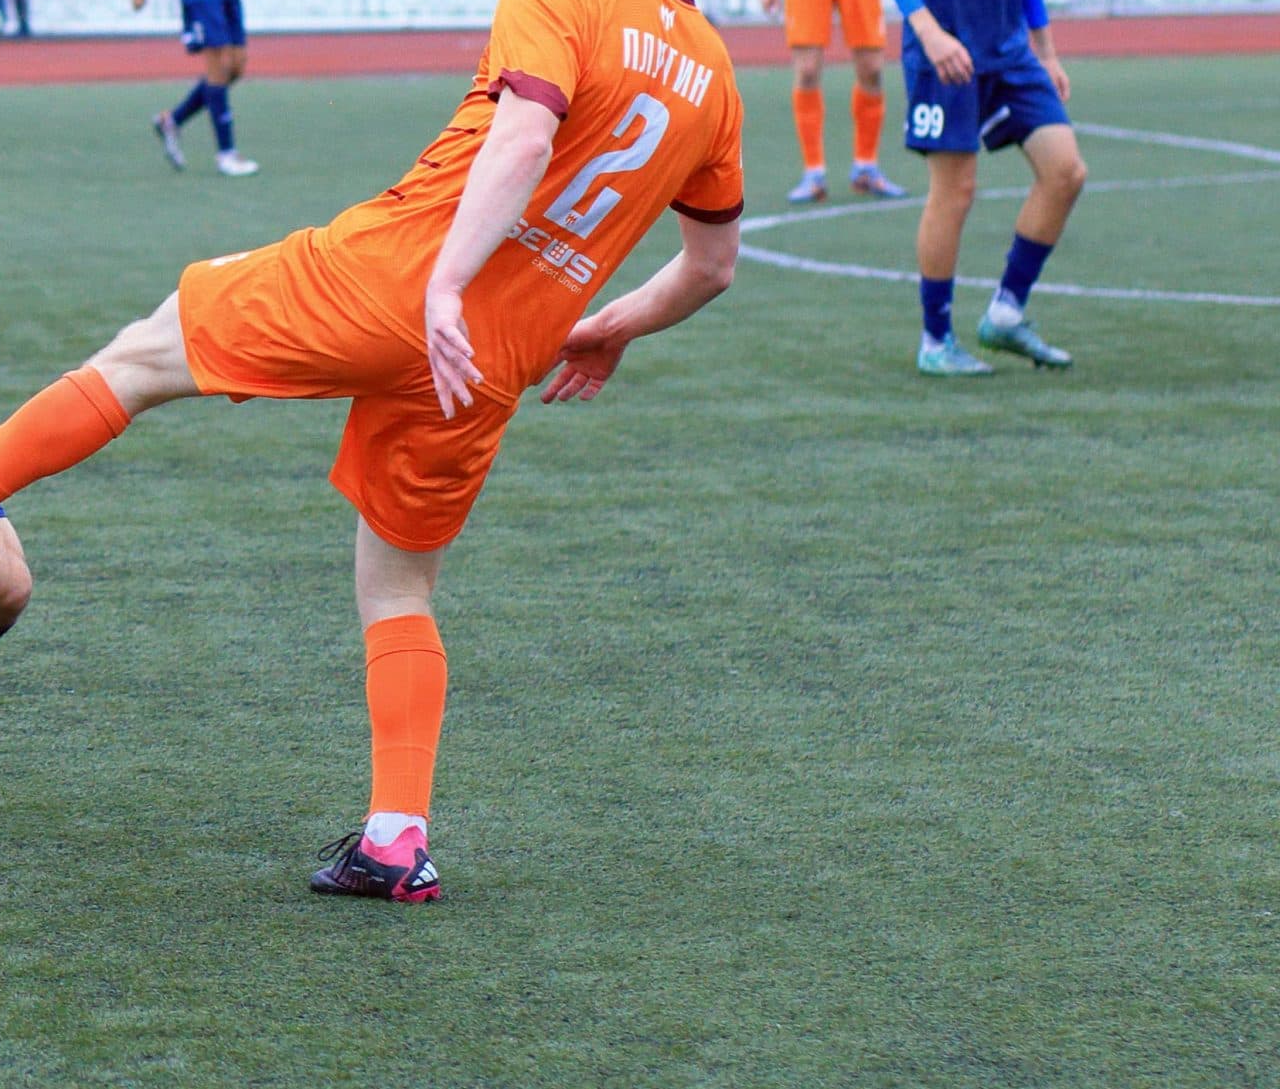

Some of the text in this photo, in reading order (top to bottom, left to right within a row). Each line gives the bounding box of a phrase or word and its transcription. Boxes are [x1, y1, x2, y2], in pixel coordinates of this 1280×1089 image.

[623, 27, 713, 108] ПЛУГИН
[913, 102, 945, 139] 99
[543, 92, 670, 240] 2
[558, 274, 583, 297] Union
